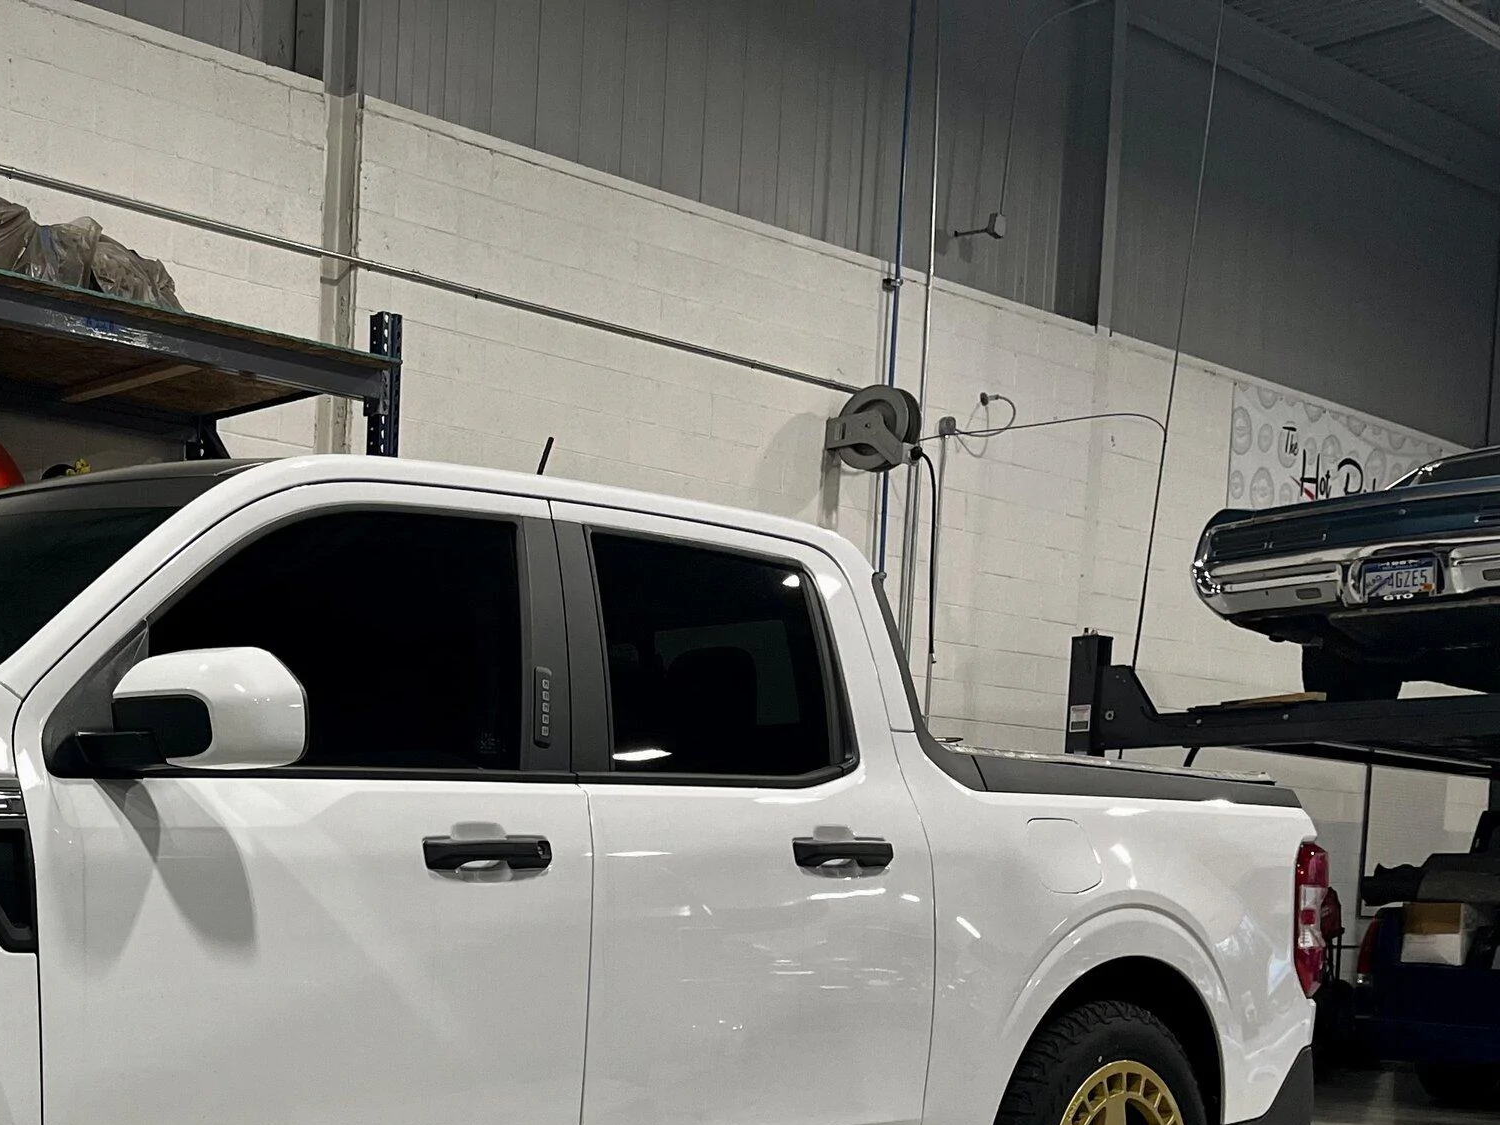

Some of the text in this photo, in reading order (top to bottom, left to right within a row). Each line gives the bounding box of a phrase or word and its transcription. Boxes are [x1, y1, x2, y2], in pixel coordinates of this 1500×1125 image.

[1282, 426, 1299, 456] The
[1300, 448, 1331, 500] Hot
[1383, 593, 1414, 601] GTO
